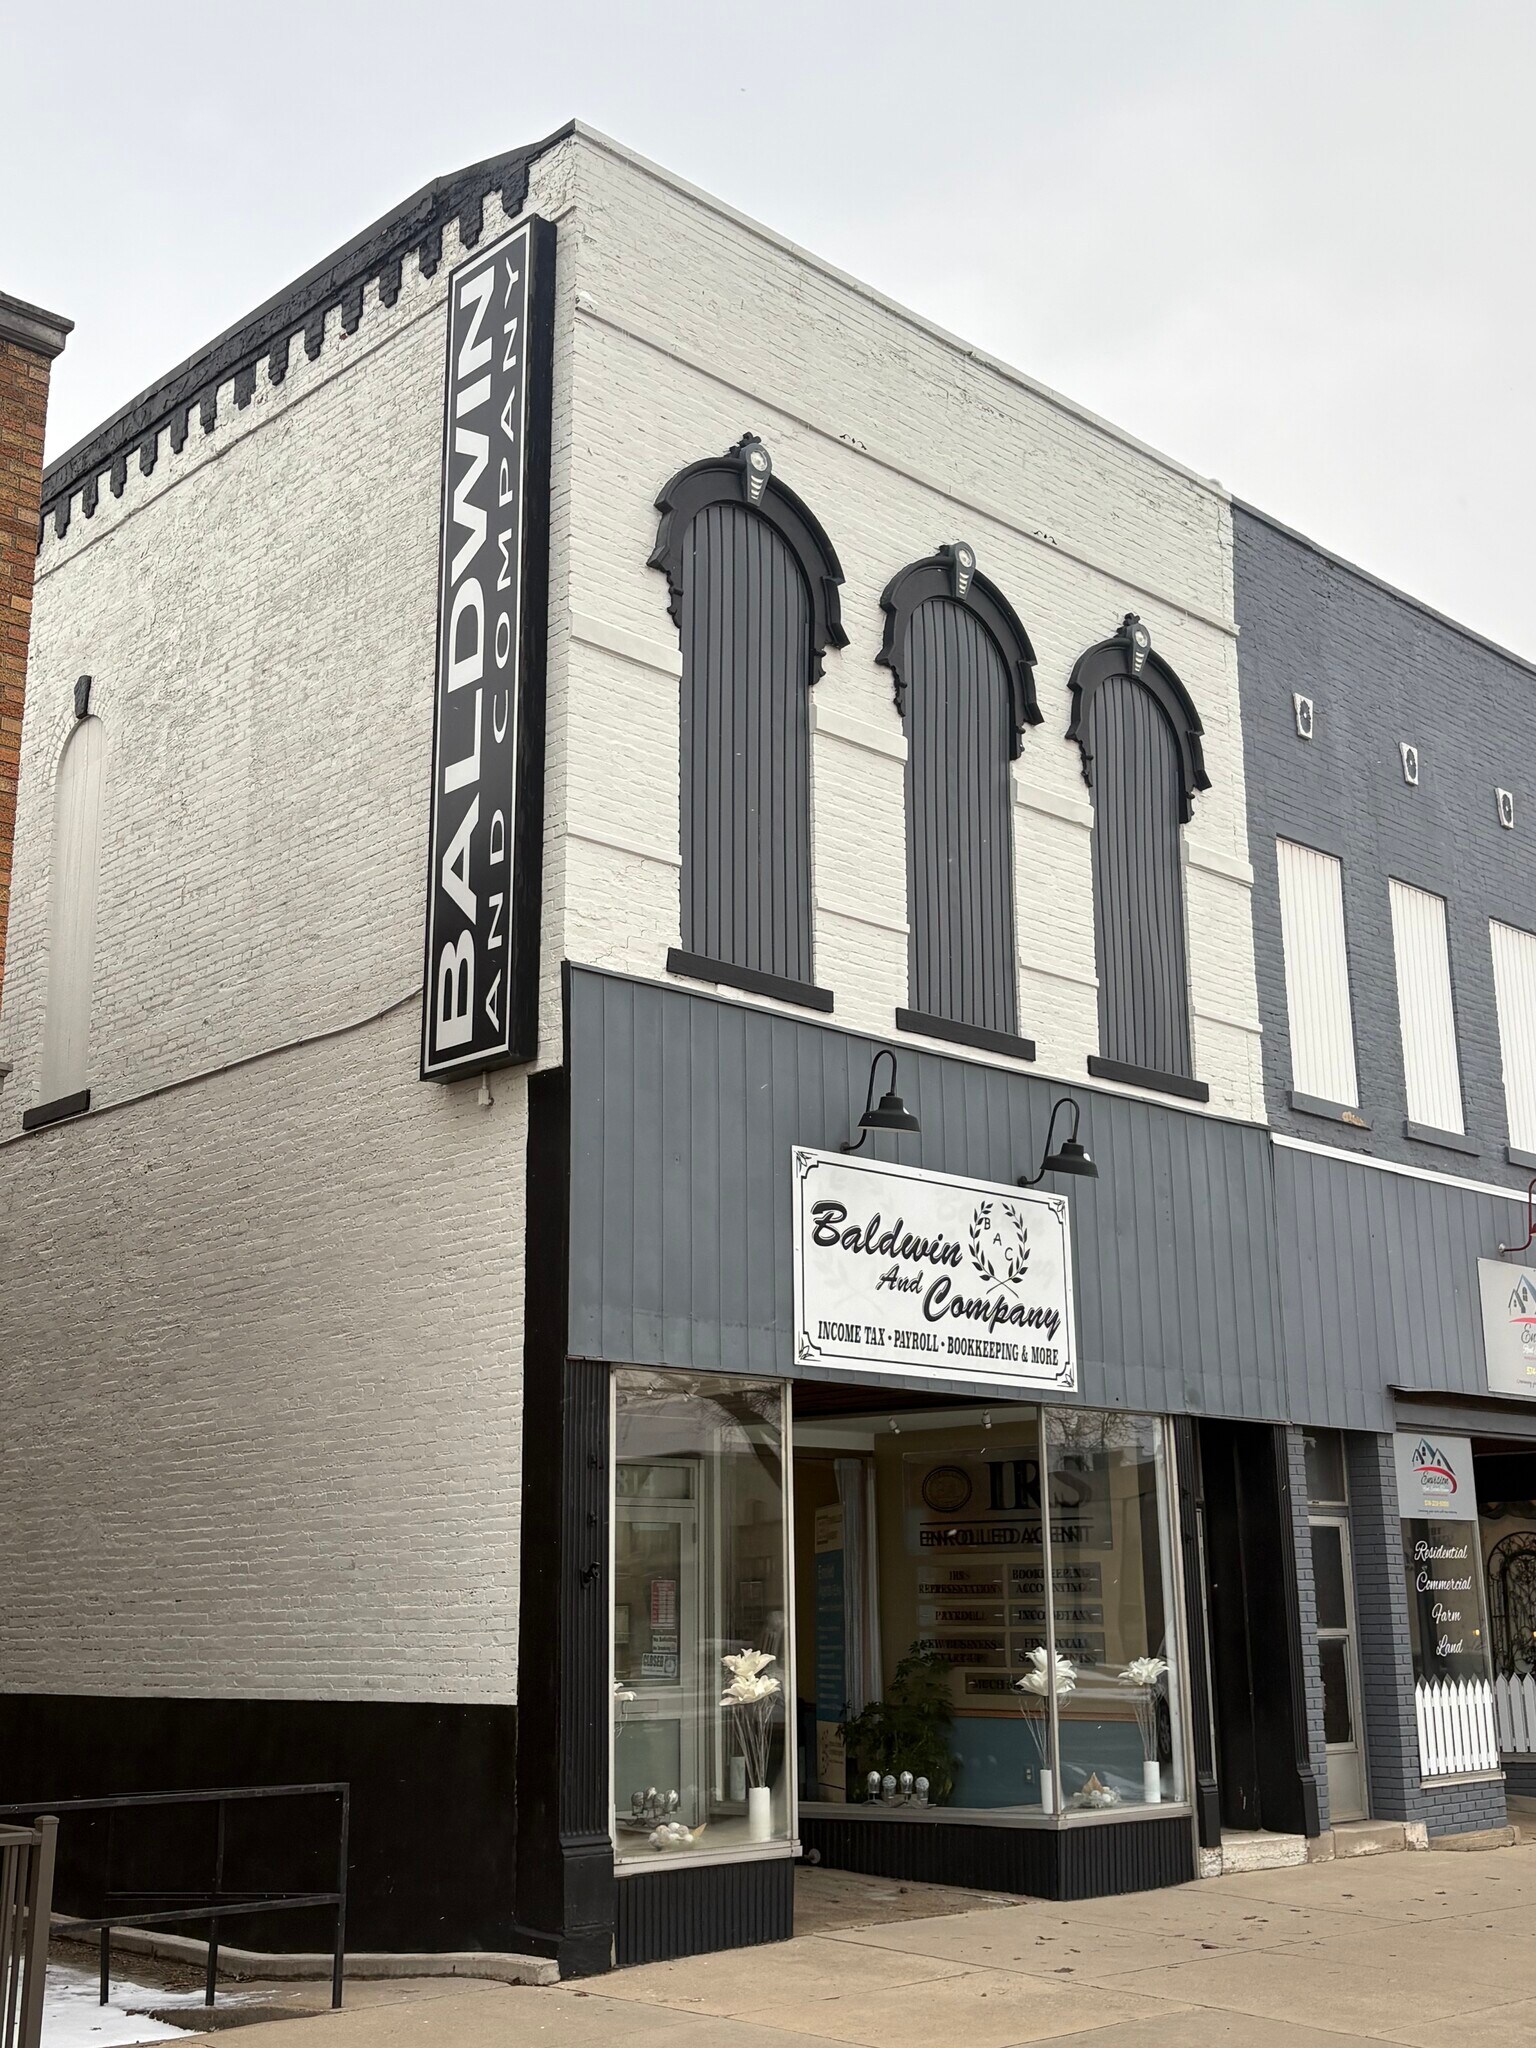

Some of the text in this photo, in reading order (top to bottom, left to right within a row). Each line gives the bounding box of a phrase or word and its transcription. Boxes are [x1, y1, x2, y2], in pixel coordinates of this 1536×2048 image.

[436, 265, 495, 1051] BALDWIN
[485, 257, 519, 1033] AND COMPANY
[810, 1200, 963, 1268] Baldwin
[984, 1217, 1013, 1261] B A C
[875, 1263, 923, 1294] And
[922, 1275, 1061, 1341] Company
[818, 1320, 1059, 1366] INCOME TAX PAYROLL BOOKKEEPING & MORE
[984, 1458, 1093, 1511] IRS
[919, 1528, 1018, 1547] ENROLLED
[1414, 1540, 1468, 1561] Residential
[1416, 1571, 1472, 1592] Commercial
[1432, 1603, 1461, 1624] Farm
[643, 1654, 664, 1667] CLOSED
[1436, 1634, 1463, 1657] Land
